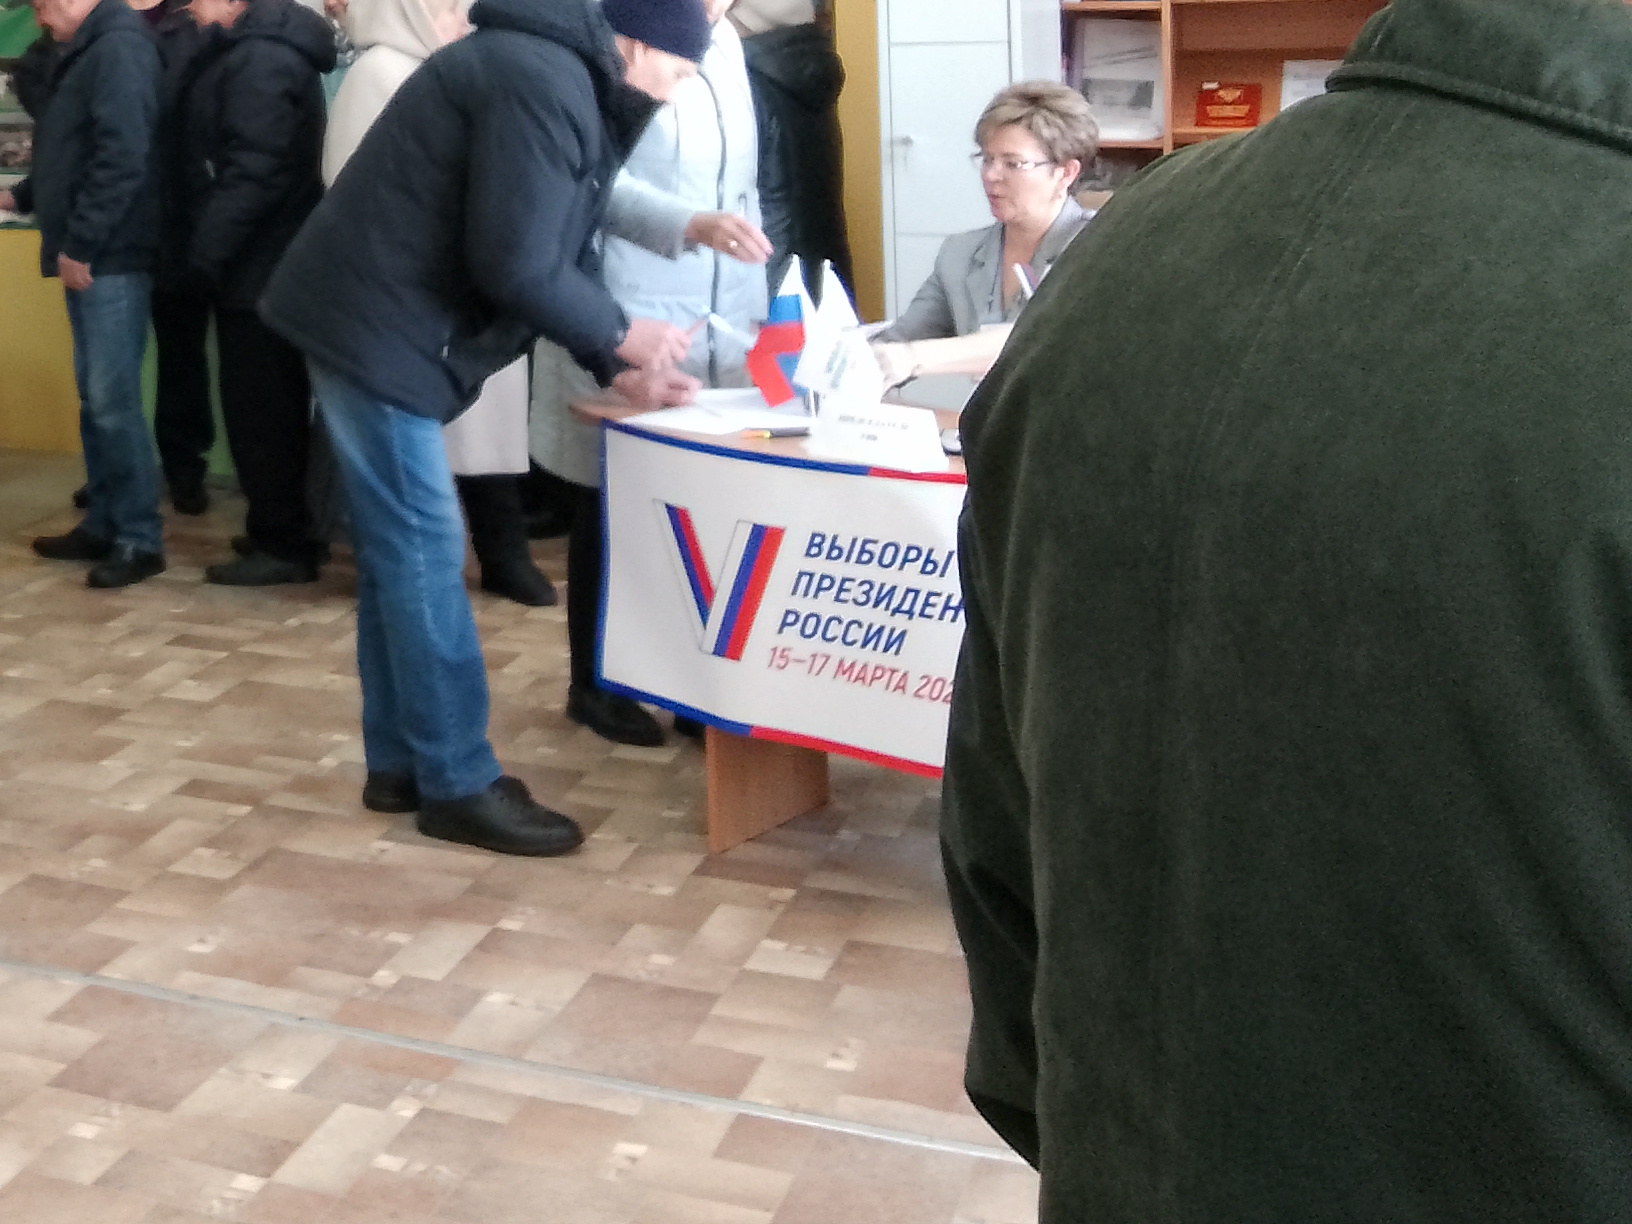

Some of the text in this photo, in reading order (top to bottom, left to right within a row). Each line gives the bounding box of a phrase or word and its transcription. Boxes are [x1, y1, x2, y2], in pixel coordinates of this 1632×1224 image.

[804, 530, 956, 579] ВЫБОРЫ
[790, 568, 966, 624] ПРЕЗИДЕН
[777, 608, 909, 657] РОССИИ
[833, 657, 911, 695] МАРТА
